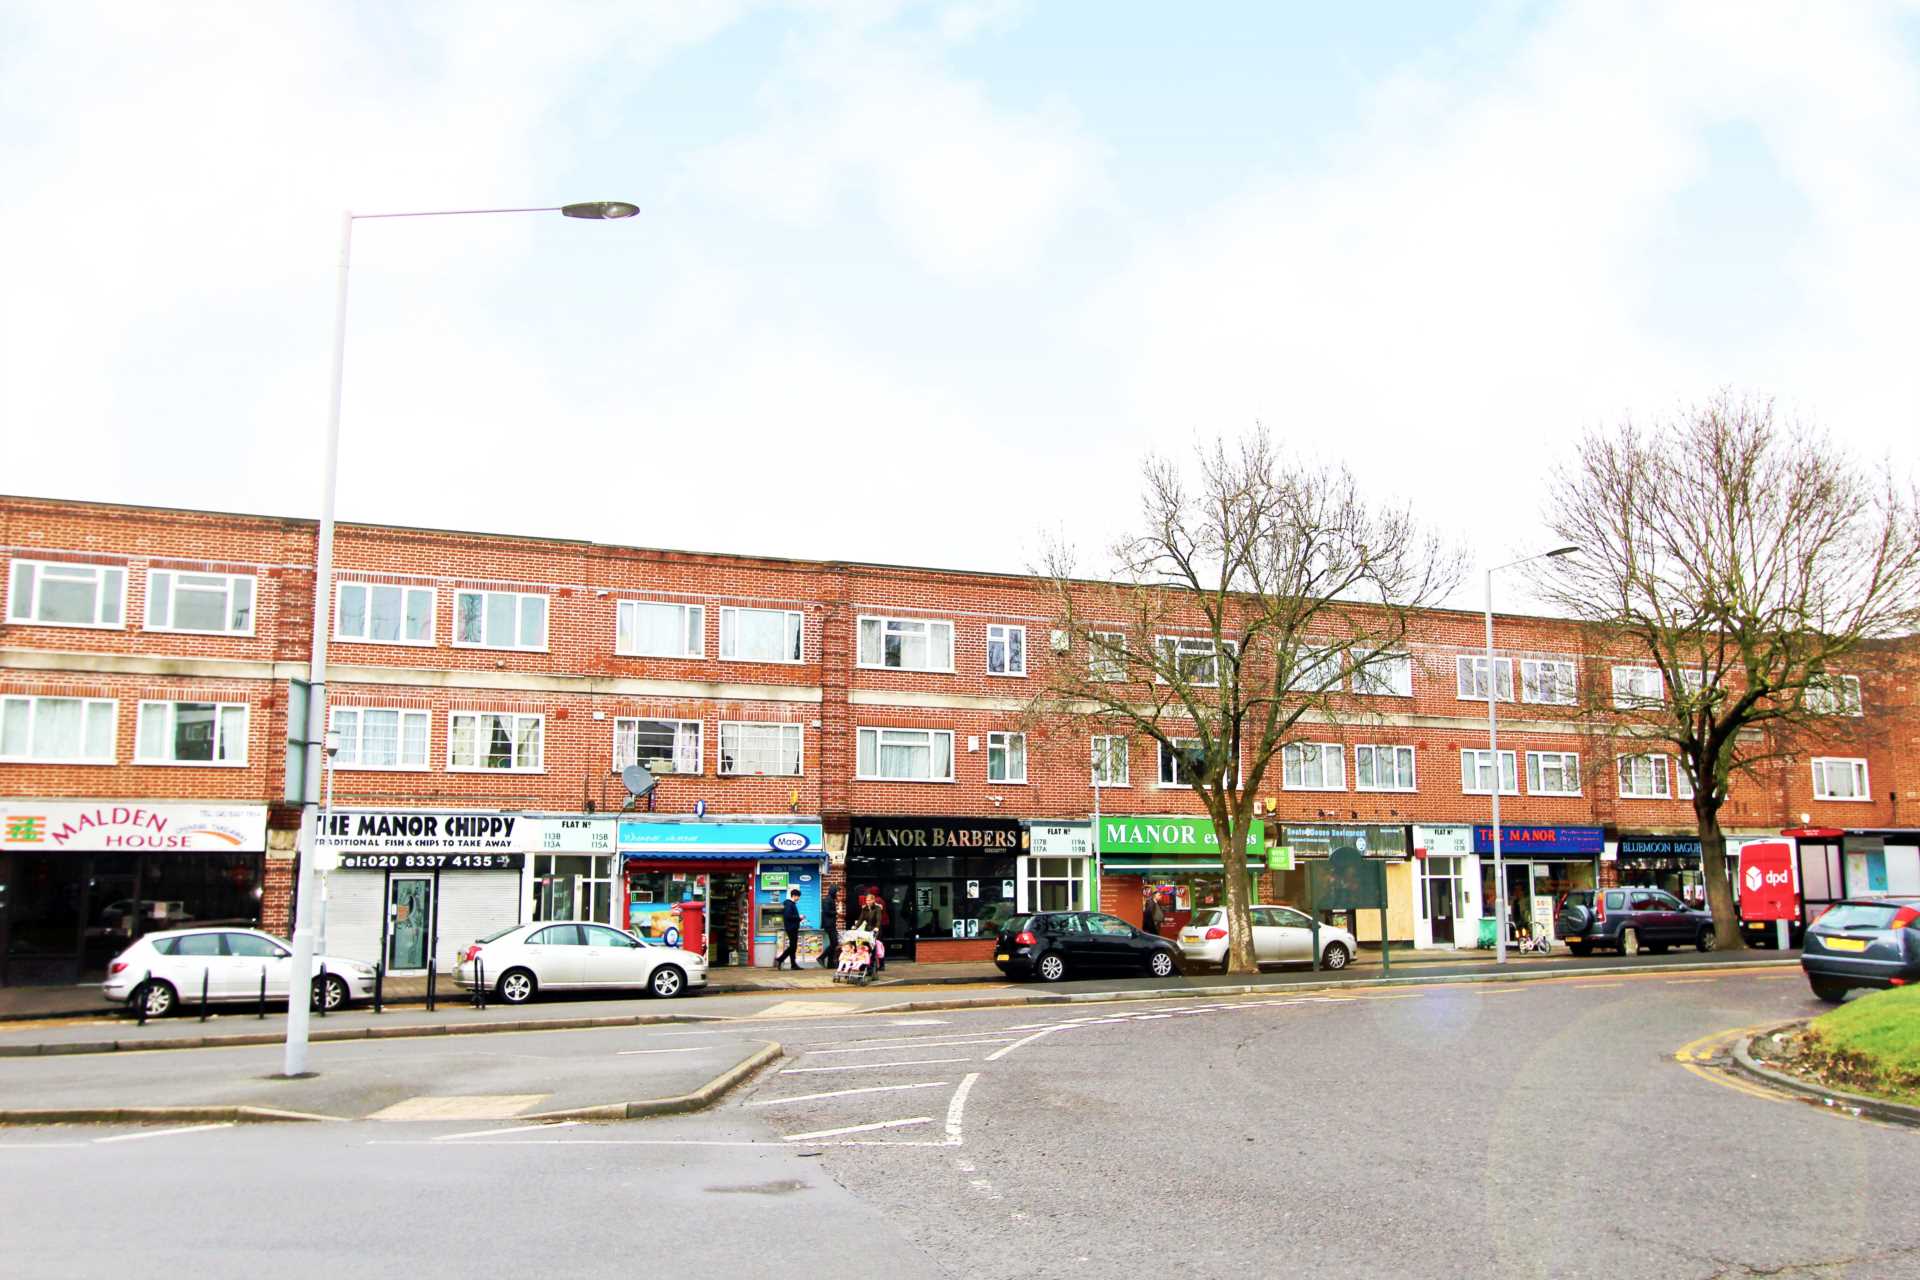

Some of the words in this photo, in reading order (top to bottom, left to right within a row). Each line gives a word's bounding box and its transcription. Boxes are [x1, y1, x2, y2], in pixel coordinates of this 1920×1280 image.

[52, 807, 167, 845] MALDEN
[357, 815, 438, 836] MANOR
[445, 816, 516, 837] CHIPPY
[106, 834, 191, 848] HOUSE
[853, 827, 927, 847] MANOR
[932, 827, 1017, 848] BARBERS
[1106, 824, 1196, 844] MANOR
[1204, 832, 1257, 844] exss
[1510, 830, 1556, 842] MANOR
[385, 839, 405, 847] FISH
[406, 839, 413, 847] &
[415, 839, 439, 847] CHIPS
[485, 840, 511, 848] AWAY
[777, 838, 802, 846] Mace
[1623, 842, 1671, 853] BLUEMOON
[405, 856, 446, 867] 8337
[452, 856, 492, 867] 4135
[1766, 870, 1788, 887] dpd
